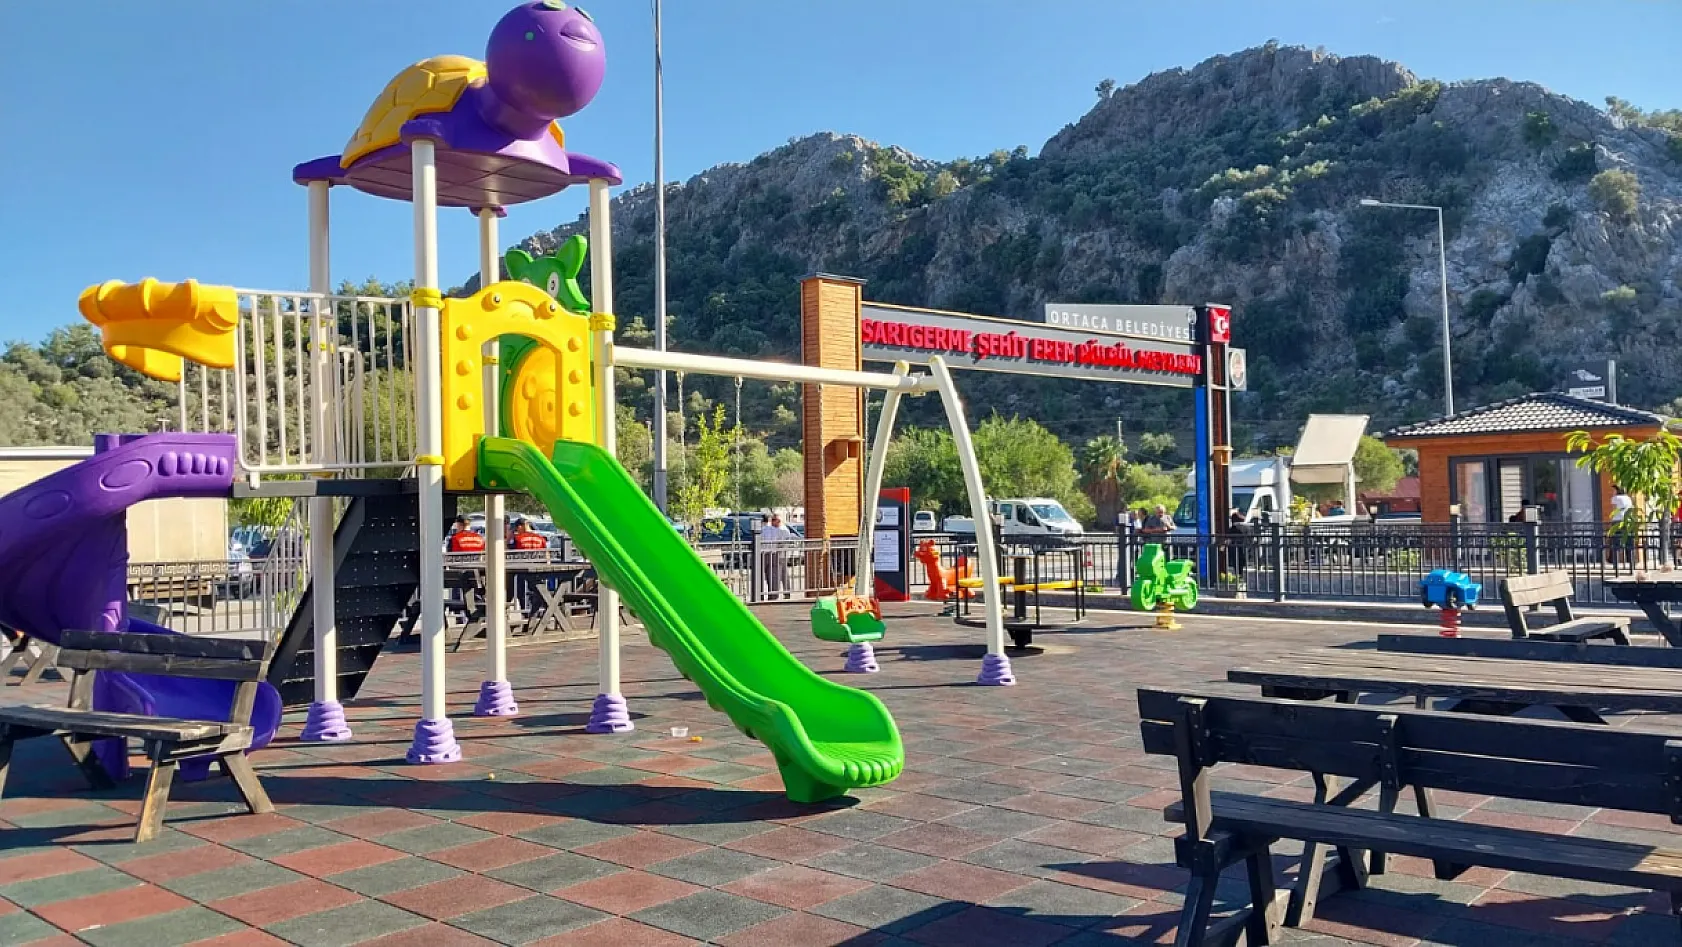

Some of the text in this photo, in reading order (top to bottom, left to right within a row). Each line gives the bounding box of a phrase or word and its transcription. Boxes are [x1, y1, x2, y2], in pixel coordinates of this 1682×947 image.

[1050, 310, 1109, 330] ORTACA
[861, 318, 973, 353] SARIGERME
[977, 331, 1029, 360] ŞEHİT
